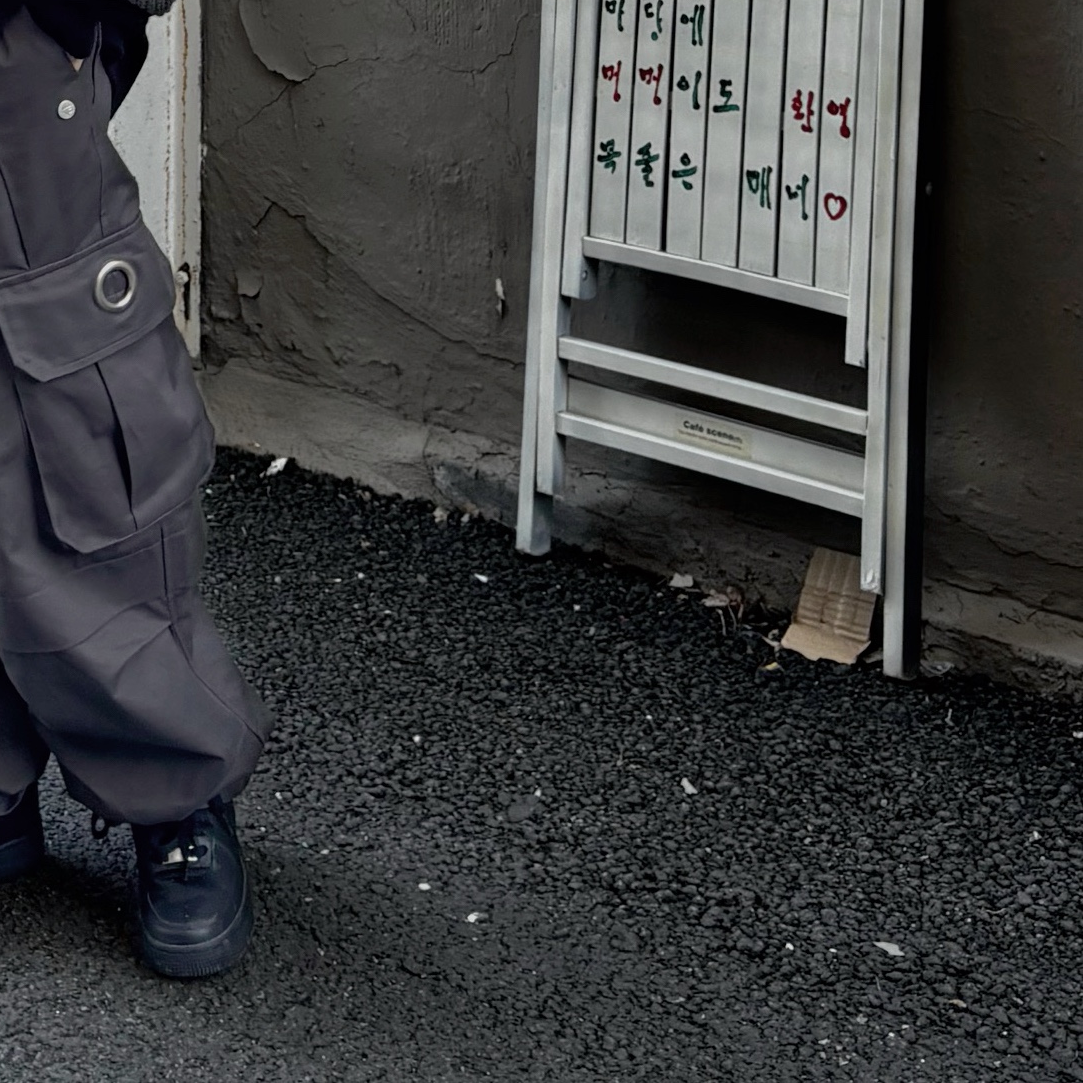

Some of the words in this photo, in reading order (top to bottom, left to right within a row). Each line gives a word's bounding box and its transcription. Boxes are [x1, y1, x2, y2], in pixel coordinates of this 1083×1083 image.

[601, 60, 740, 113] 멍멍이도
[791, 89, 851, 139] 환영
[597, 138, 698, 191] 목줄은
